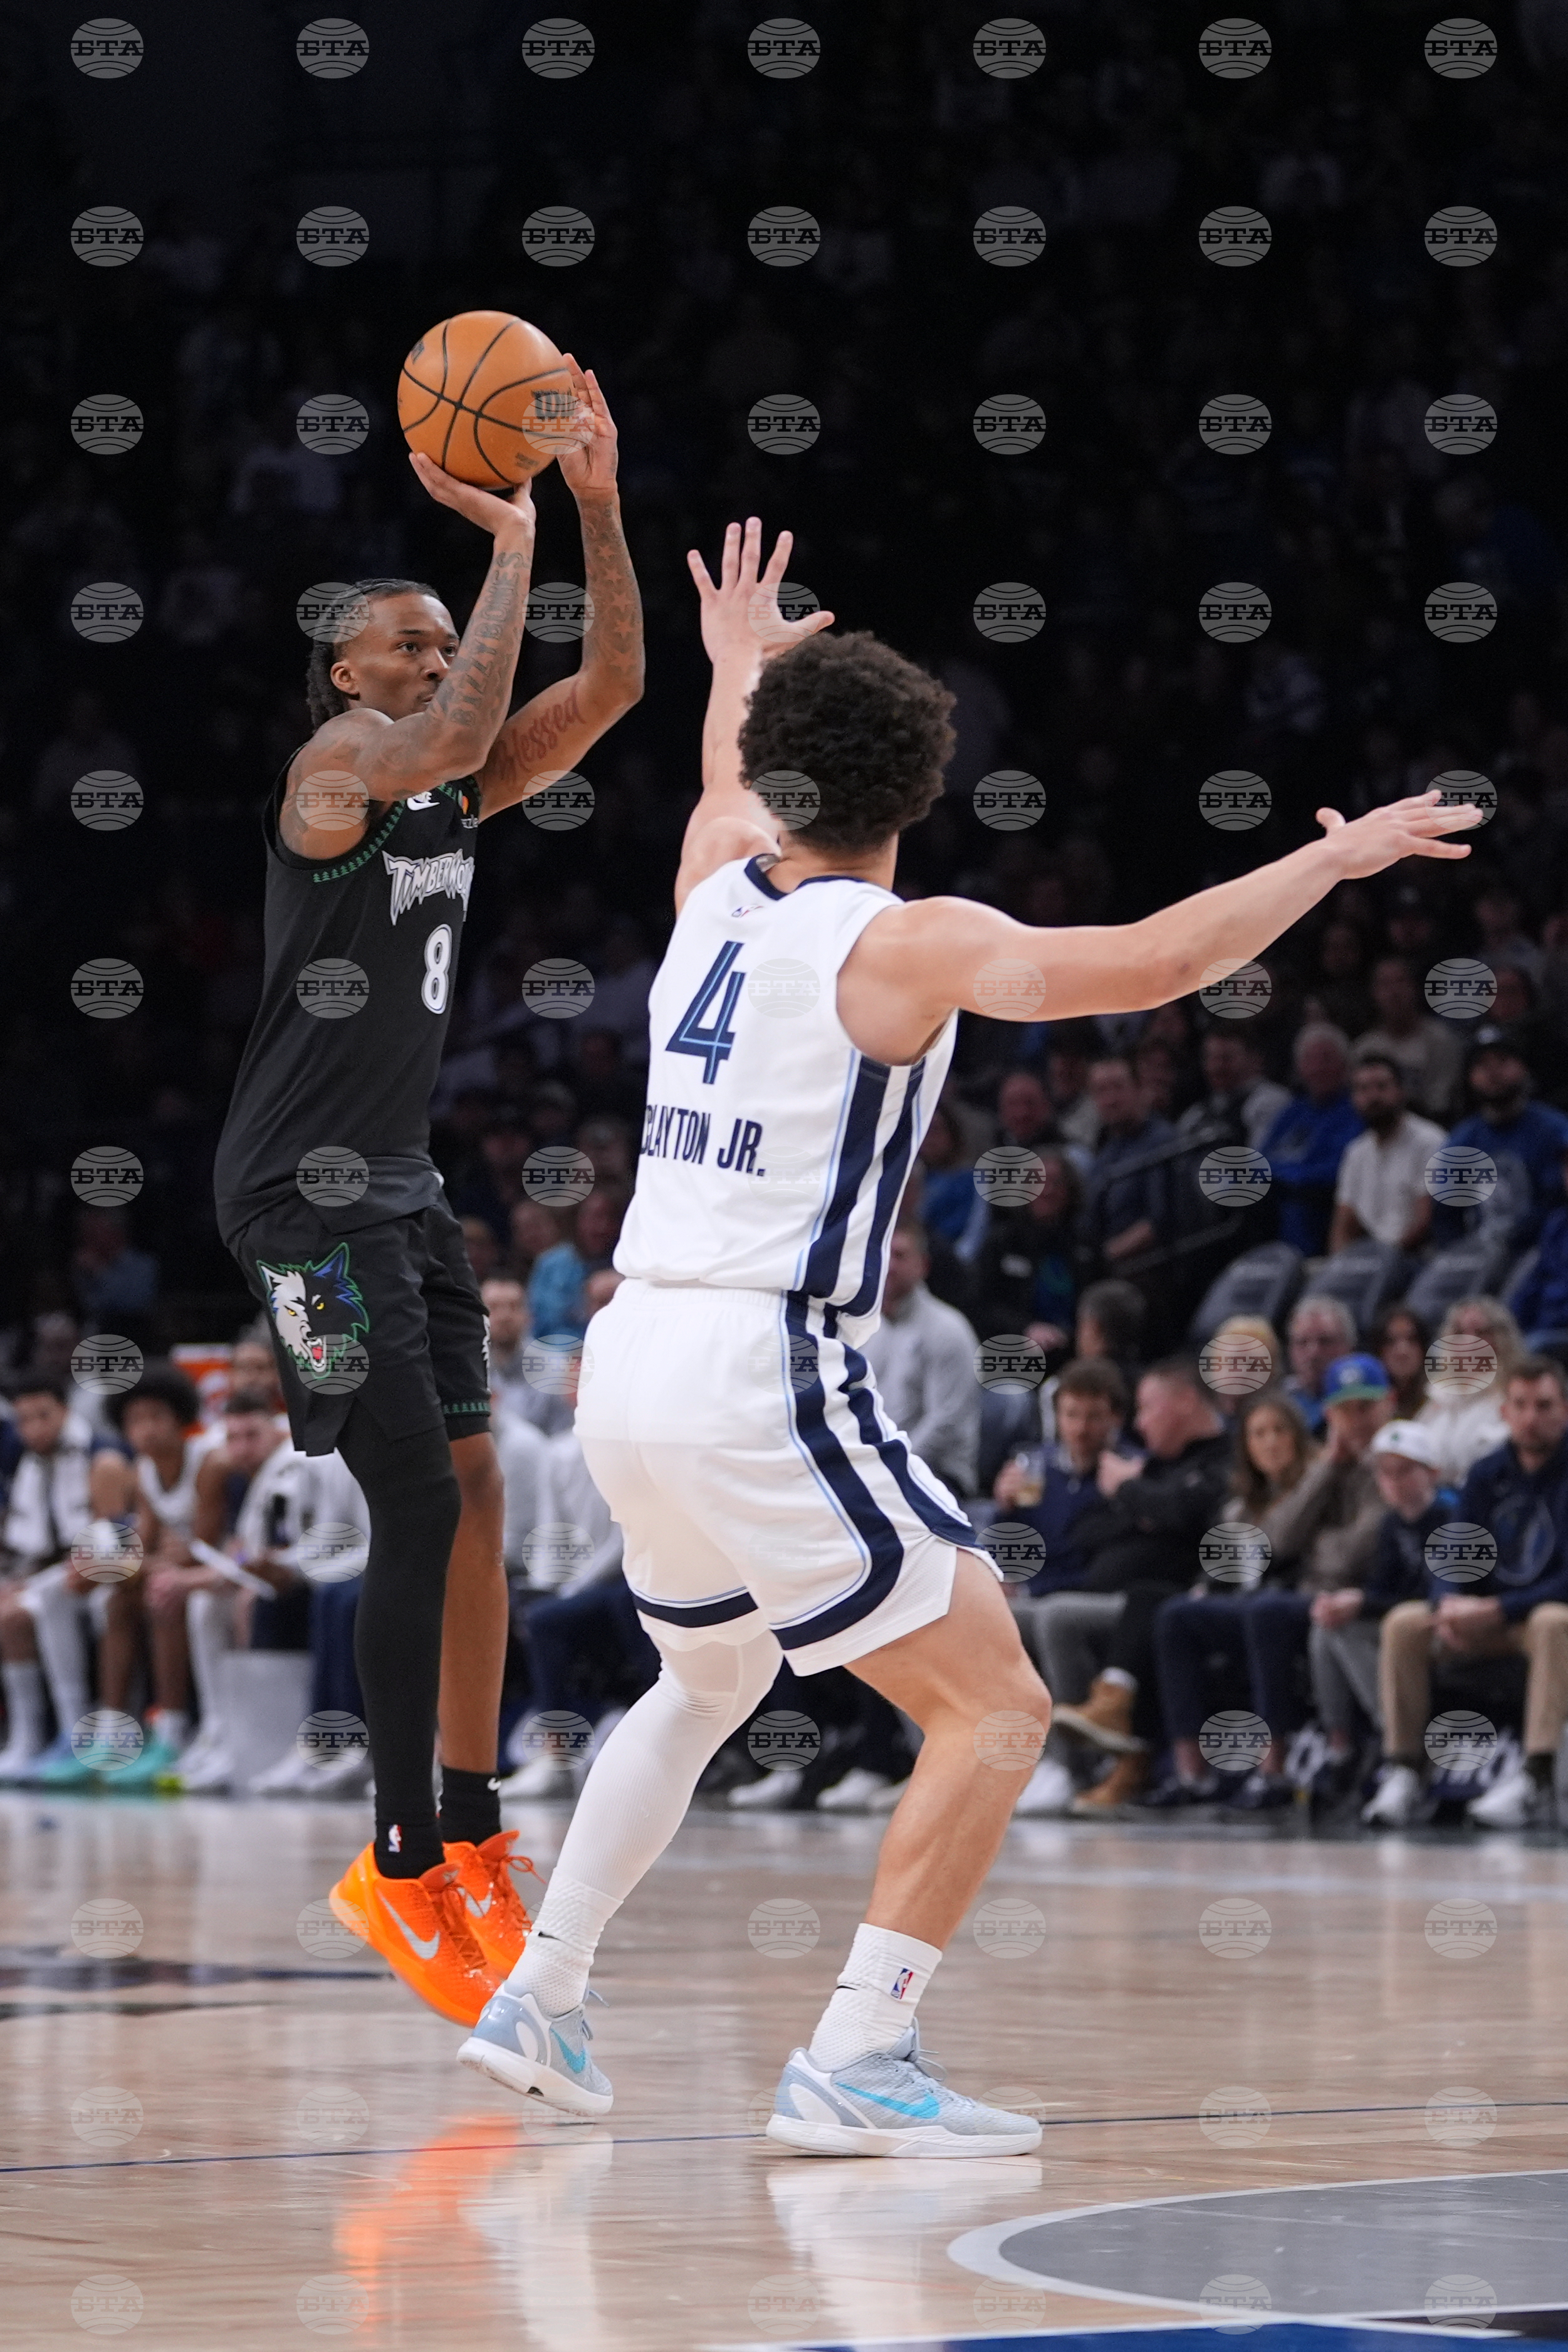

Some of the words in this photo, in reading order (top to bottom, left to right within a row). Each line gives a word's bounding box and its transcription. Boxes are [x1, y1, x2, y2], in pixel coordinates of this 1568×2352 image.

[421, 924, 452, 1014] 8
[665, 940, 746, 1085] 4
[717, 1118, 765, 1177] JR.
